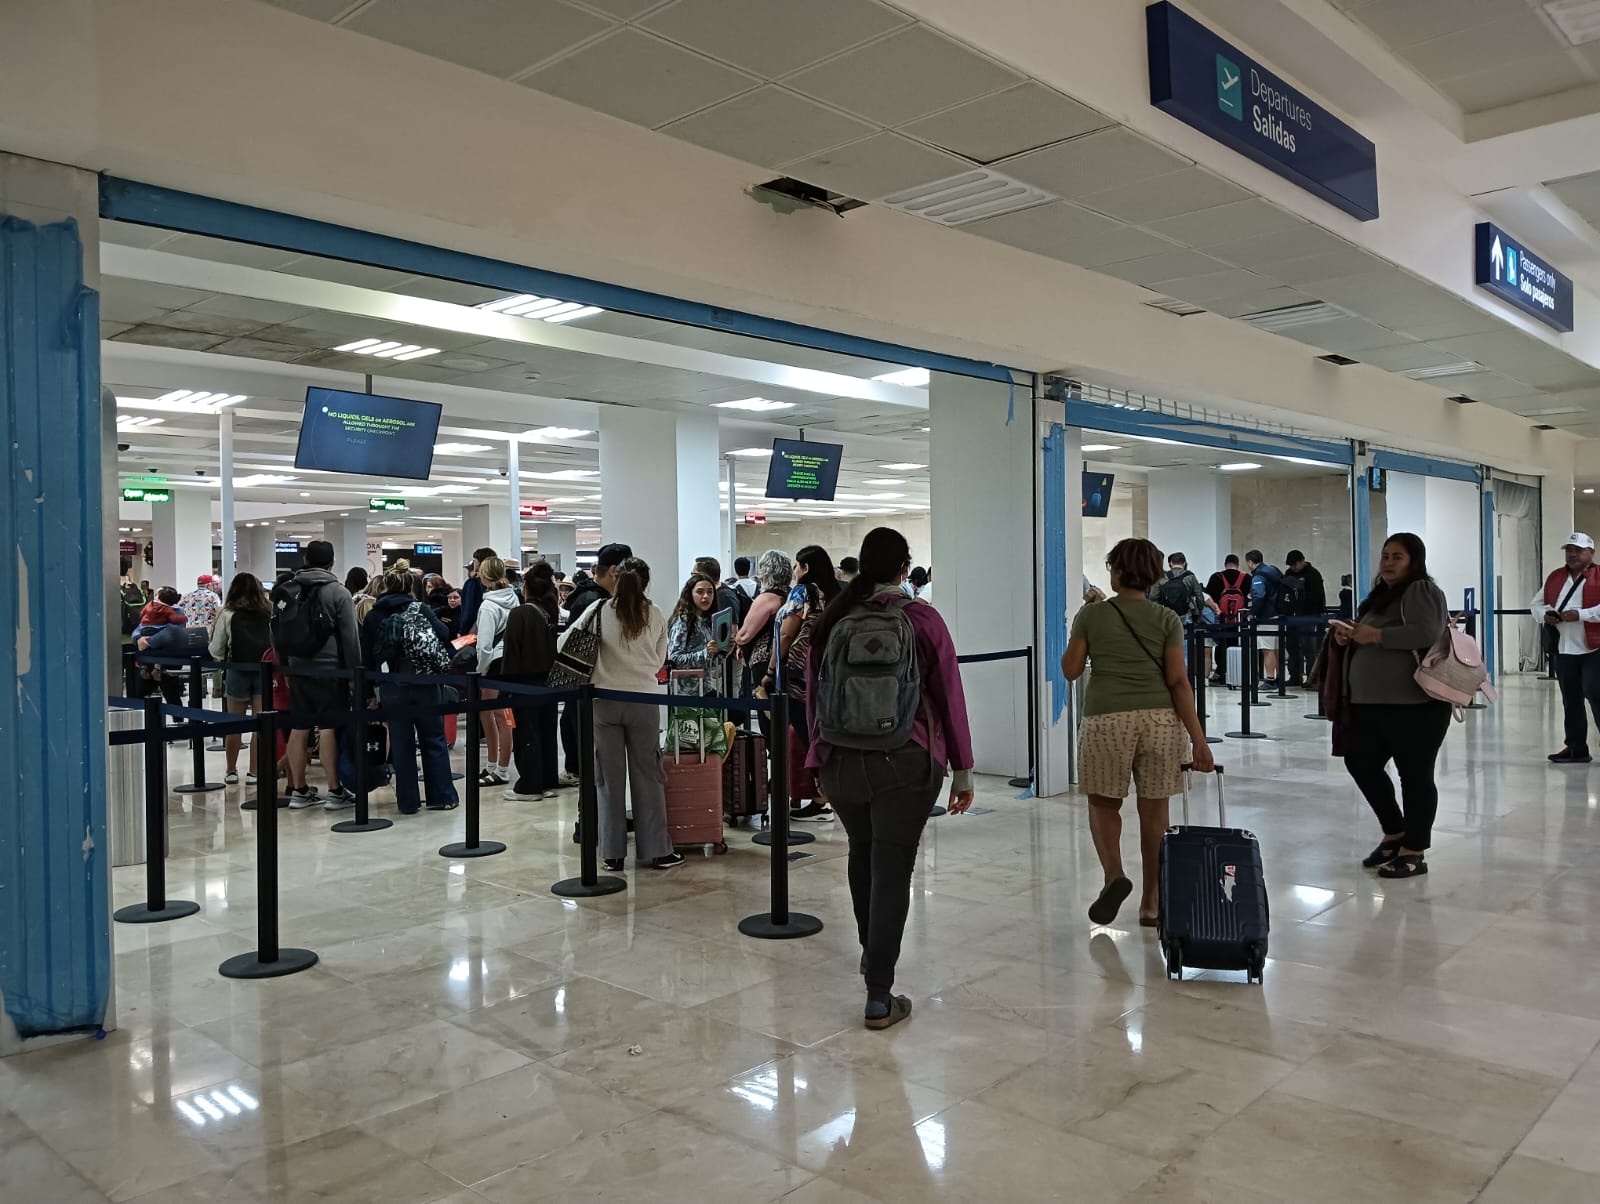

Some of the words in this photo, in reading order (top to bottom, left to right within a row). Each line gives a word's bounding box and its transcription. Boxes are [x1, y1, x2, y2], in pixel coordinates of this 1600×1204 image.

[1251, 68, 1312, 131] Departures
[1253, 104, 1296, 153] Salidas
[1520, 250, 1546, 284] Passengers
[1546, 272, 1556, 294] only
[1520, 273, 1532, 297] Solo
[1532, 285, 1555, 310] pasajeros
[124, 489, 144, 498] Open
[370, 499, 386, 507] Open
[1466, 591, 1472, 611] 1
